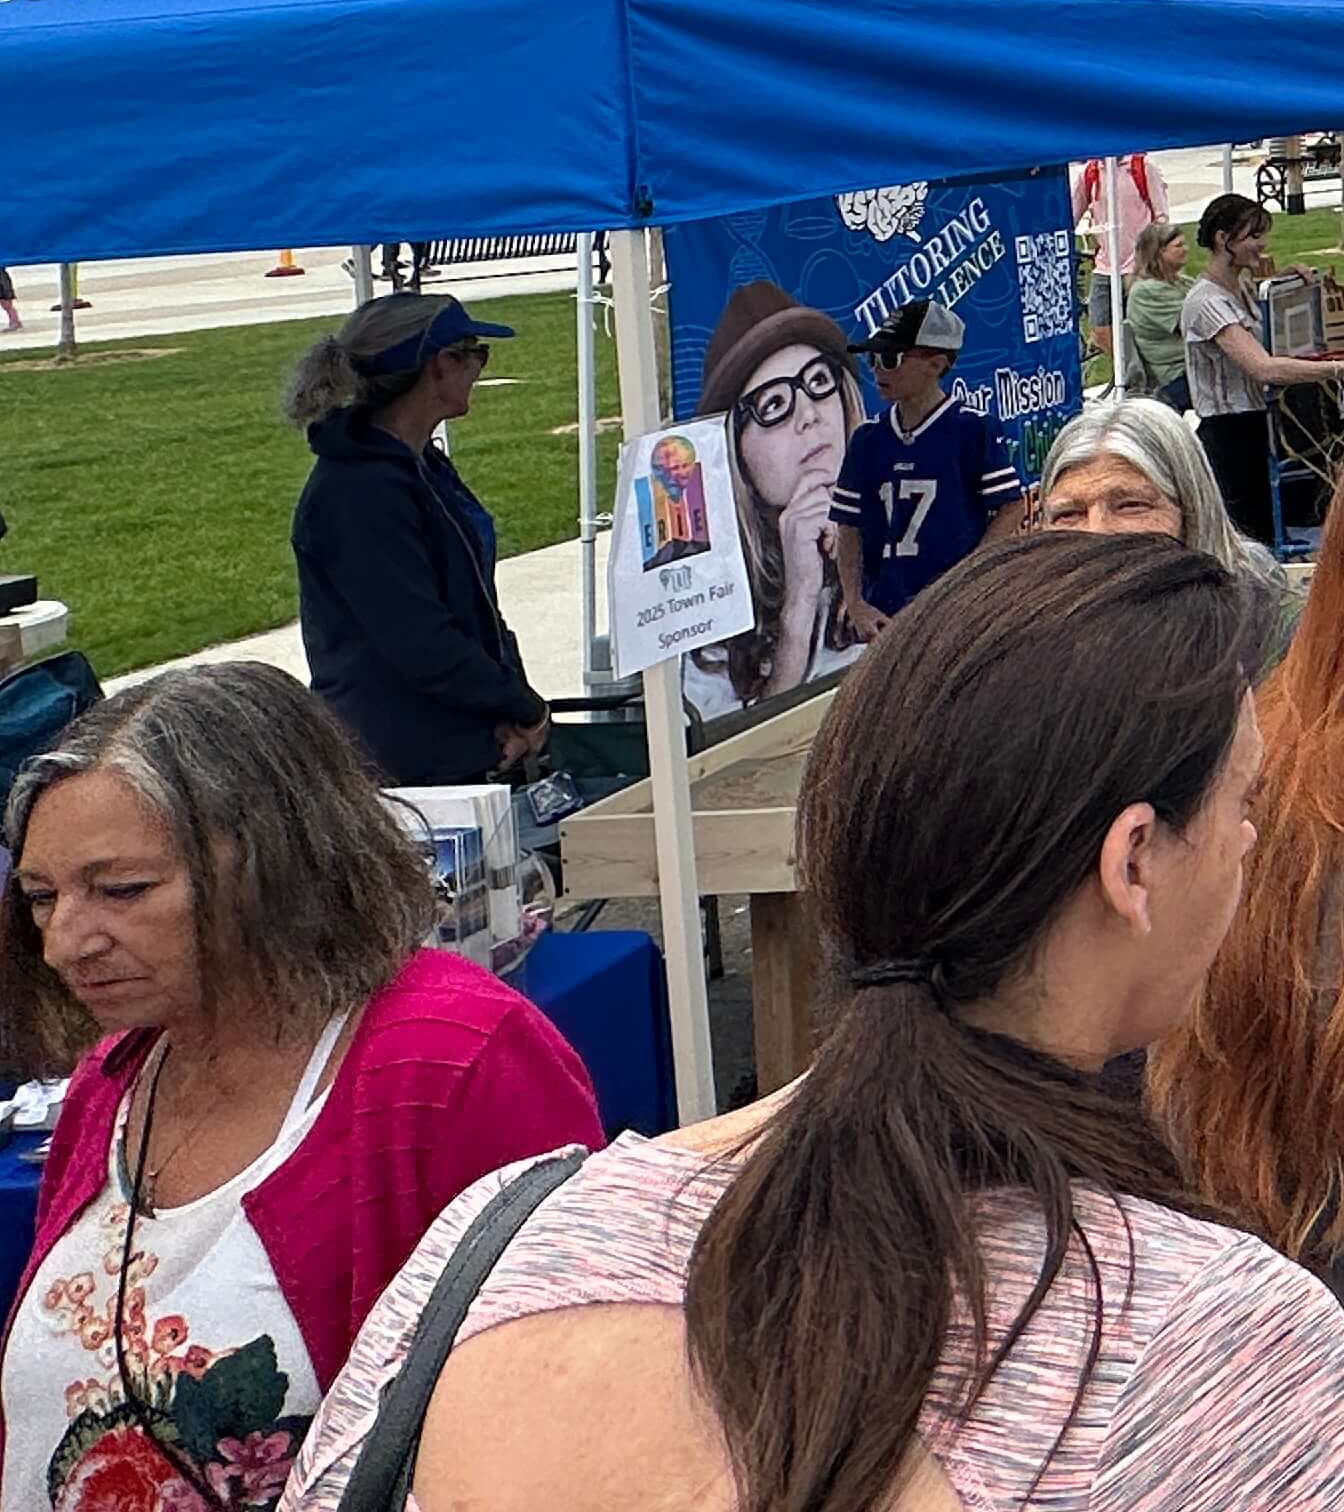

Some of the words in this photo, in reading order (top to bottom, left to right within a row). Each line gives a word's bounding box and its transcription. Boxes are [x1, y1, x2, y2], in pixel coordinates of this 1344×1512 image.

[854, 197, 992, 339] TUTORING
[929, 231, 1006, 311] LENCE
[995, 365, 1066, 422] Mission
[879, 479, 938, 558] 17
[636, 605, 665, 628] 2025
[669, 593, 705, 614] Town
[709, 581, 735, 602] Fair
[658, 618, 715, 649] Sponsor
